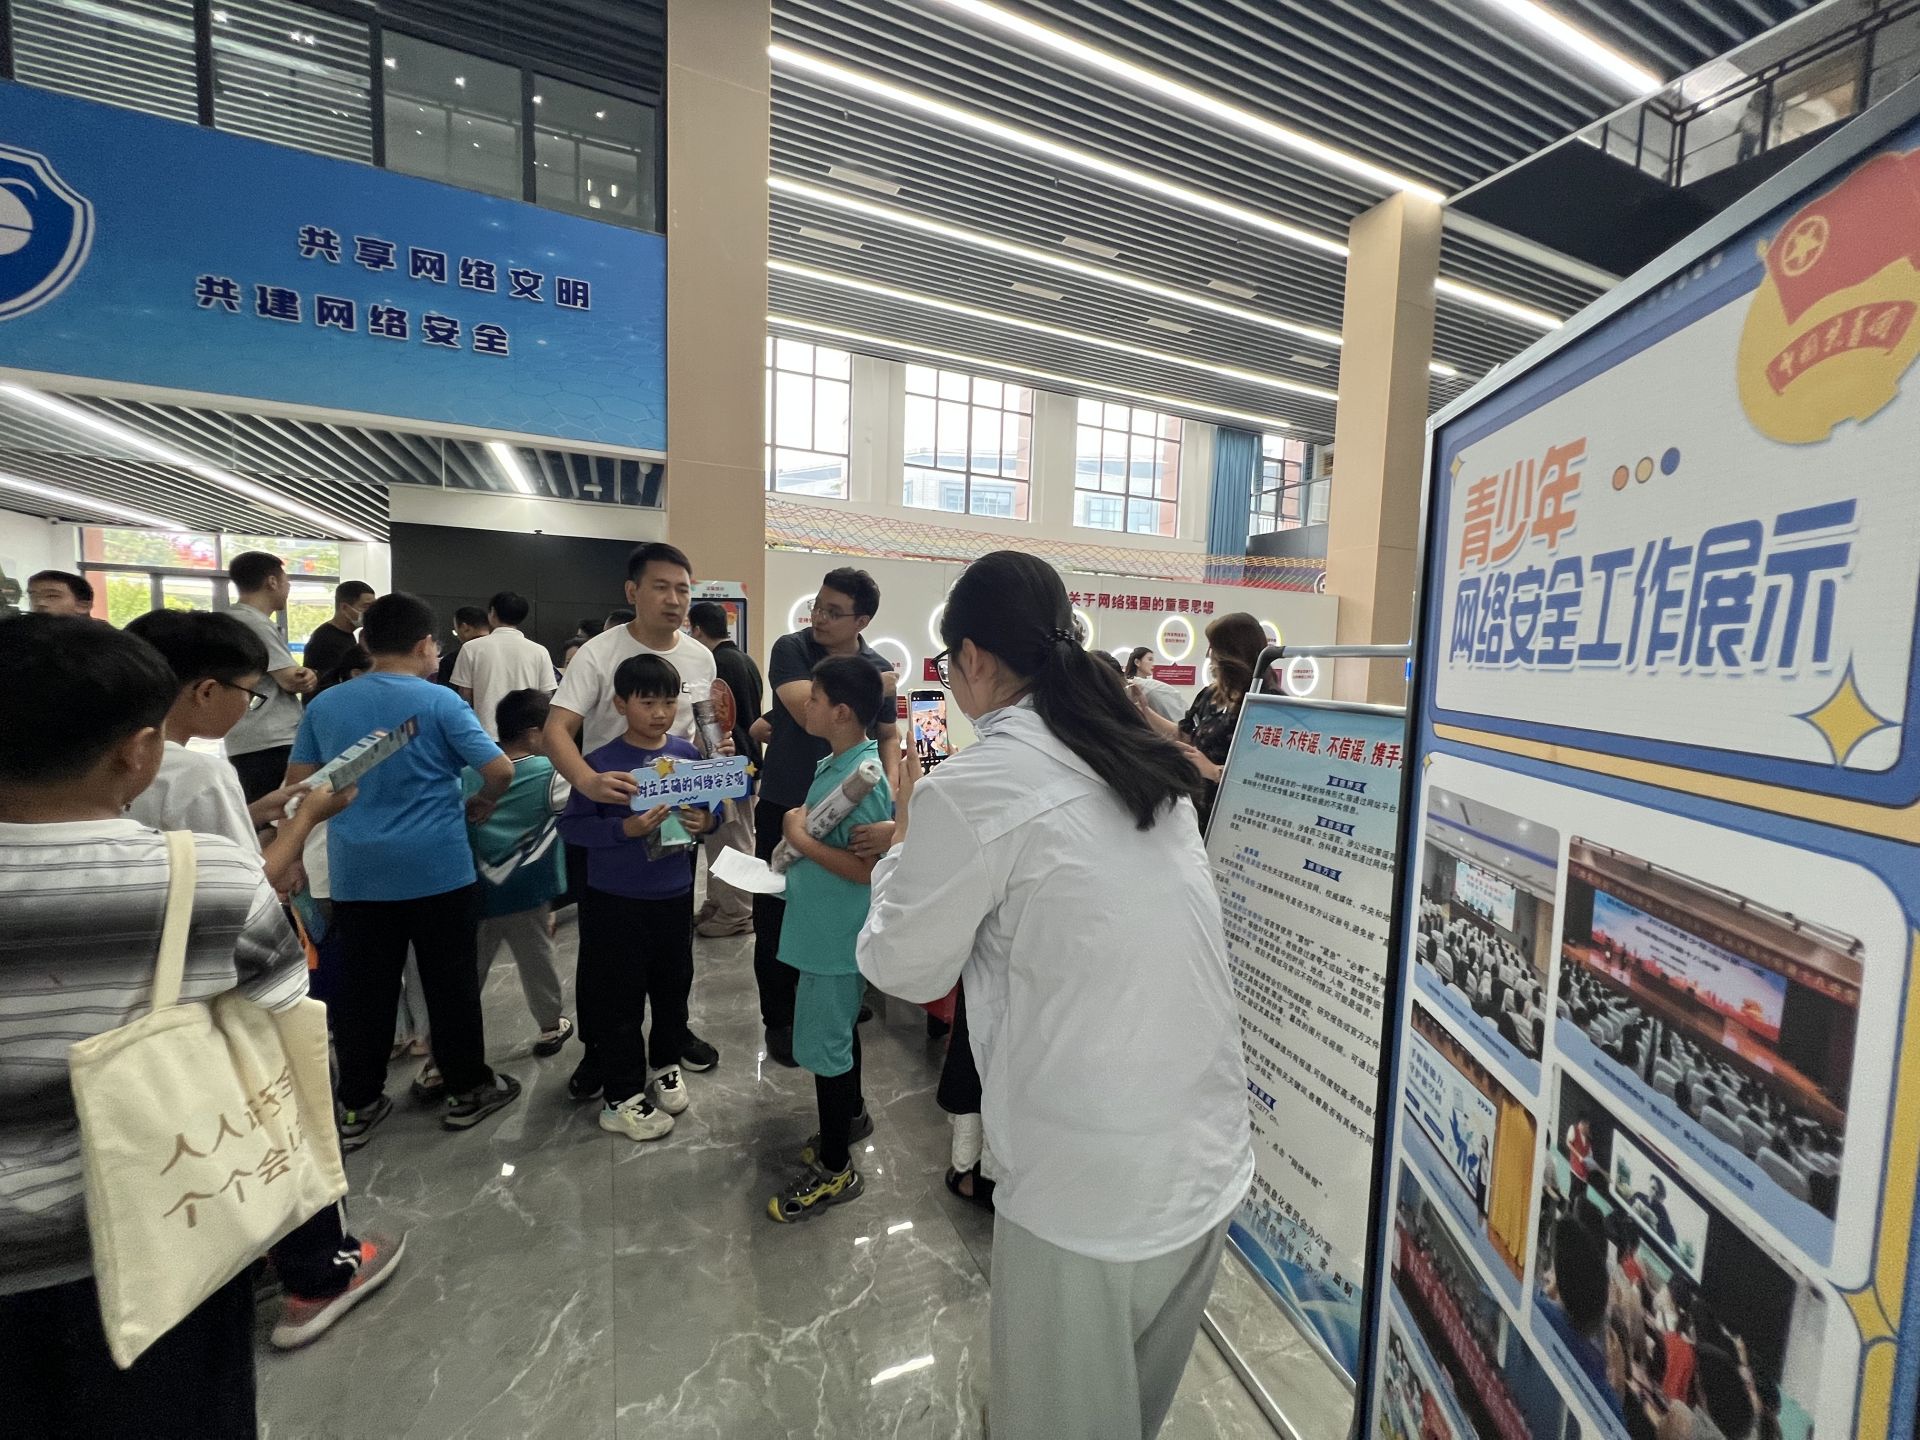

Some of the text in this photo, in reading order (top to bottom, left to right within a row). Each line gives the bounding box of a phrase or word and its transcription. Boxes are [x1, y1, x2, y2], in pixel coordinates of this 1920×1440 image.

[299, 225, 591, 310] 共享网络文明
[195, 274, 510, 355] 共建网络安全
[1459, 436, 1586, 570] 青少年
[1068, 591, 1214, 615] 关于网络强国的重要思想
[1449, 498, 1857, 667] 网络安全工作展示
